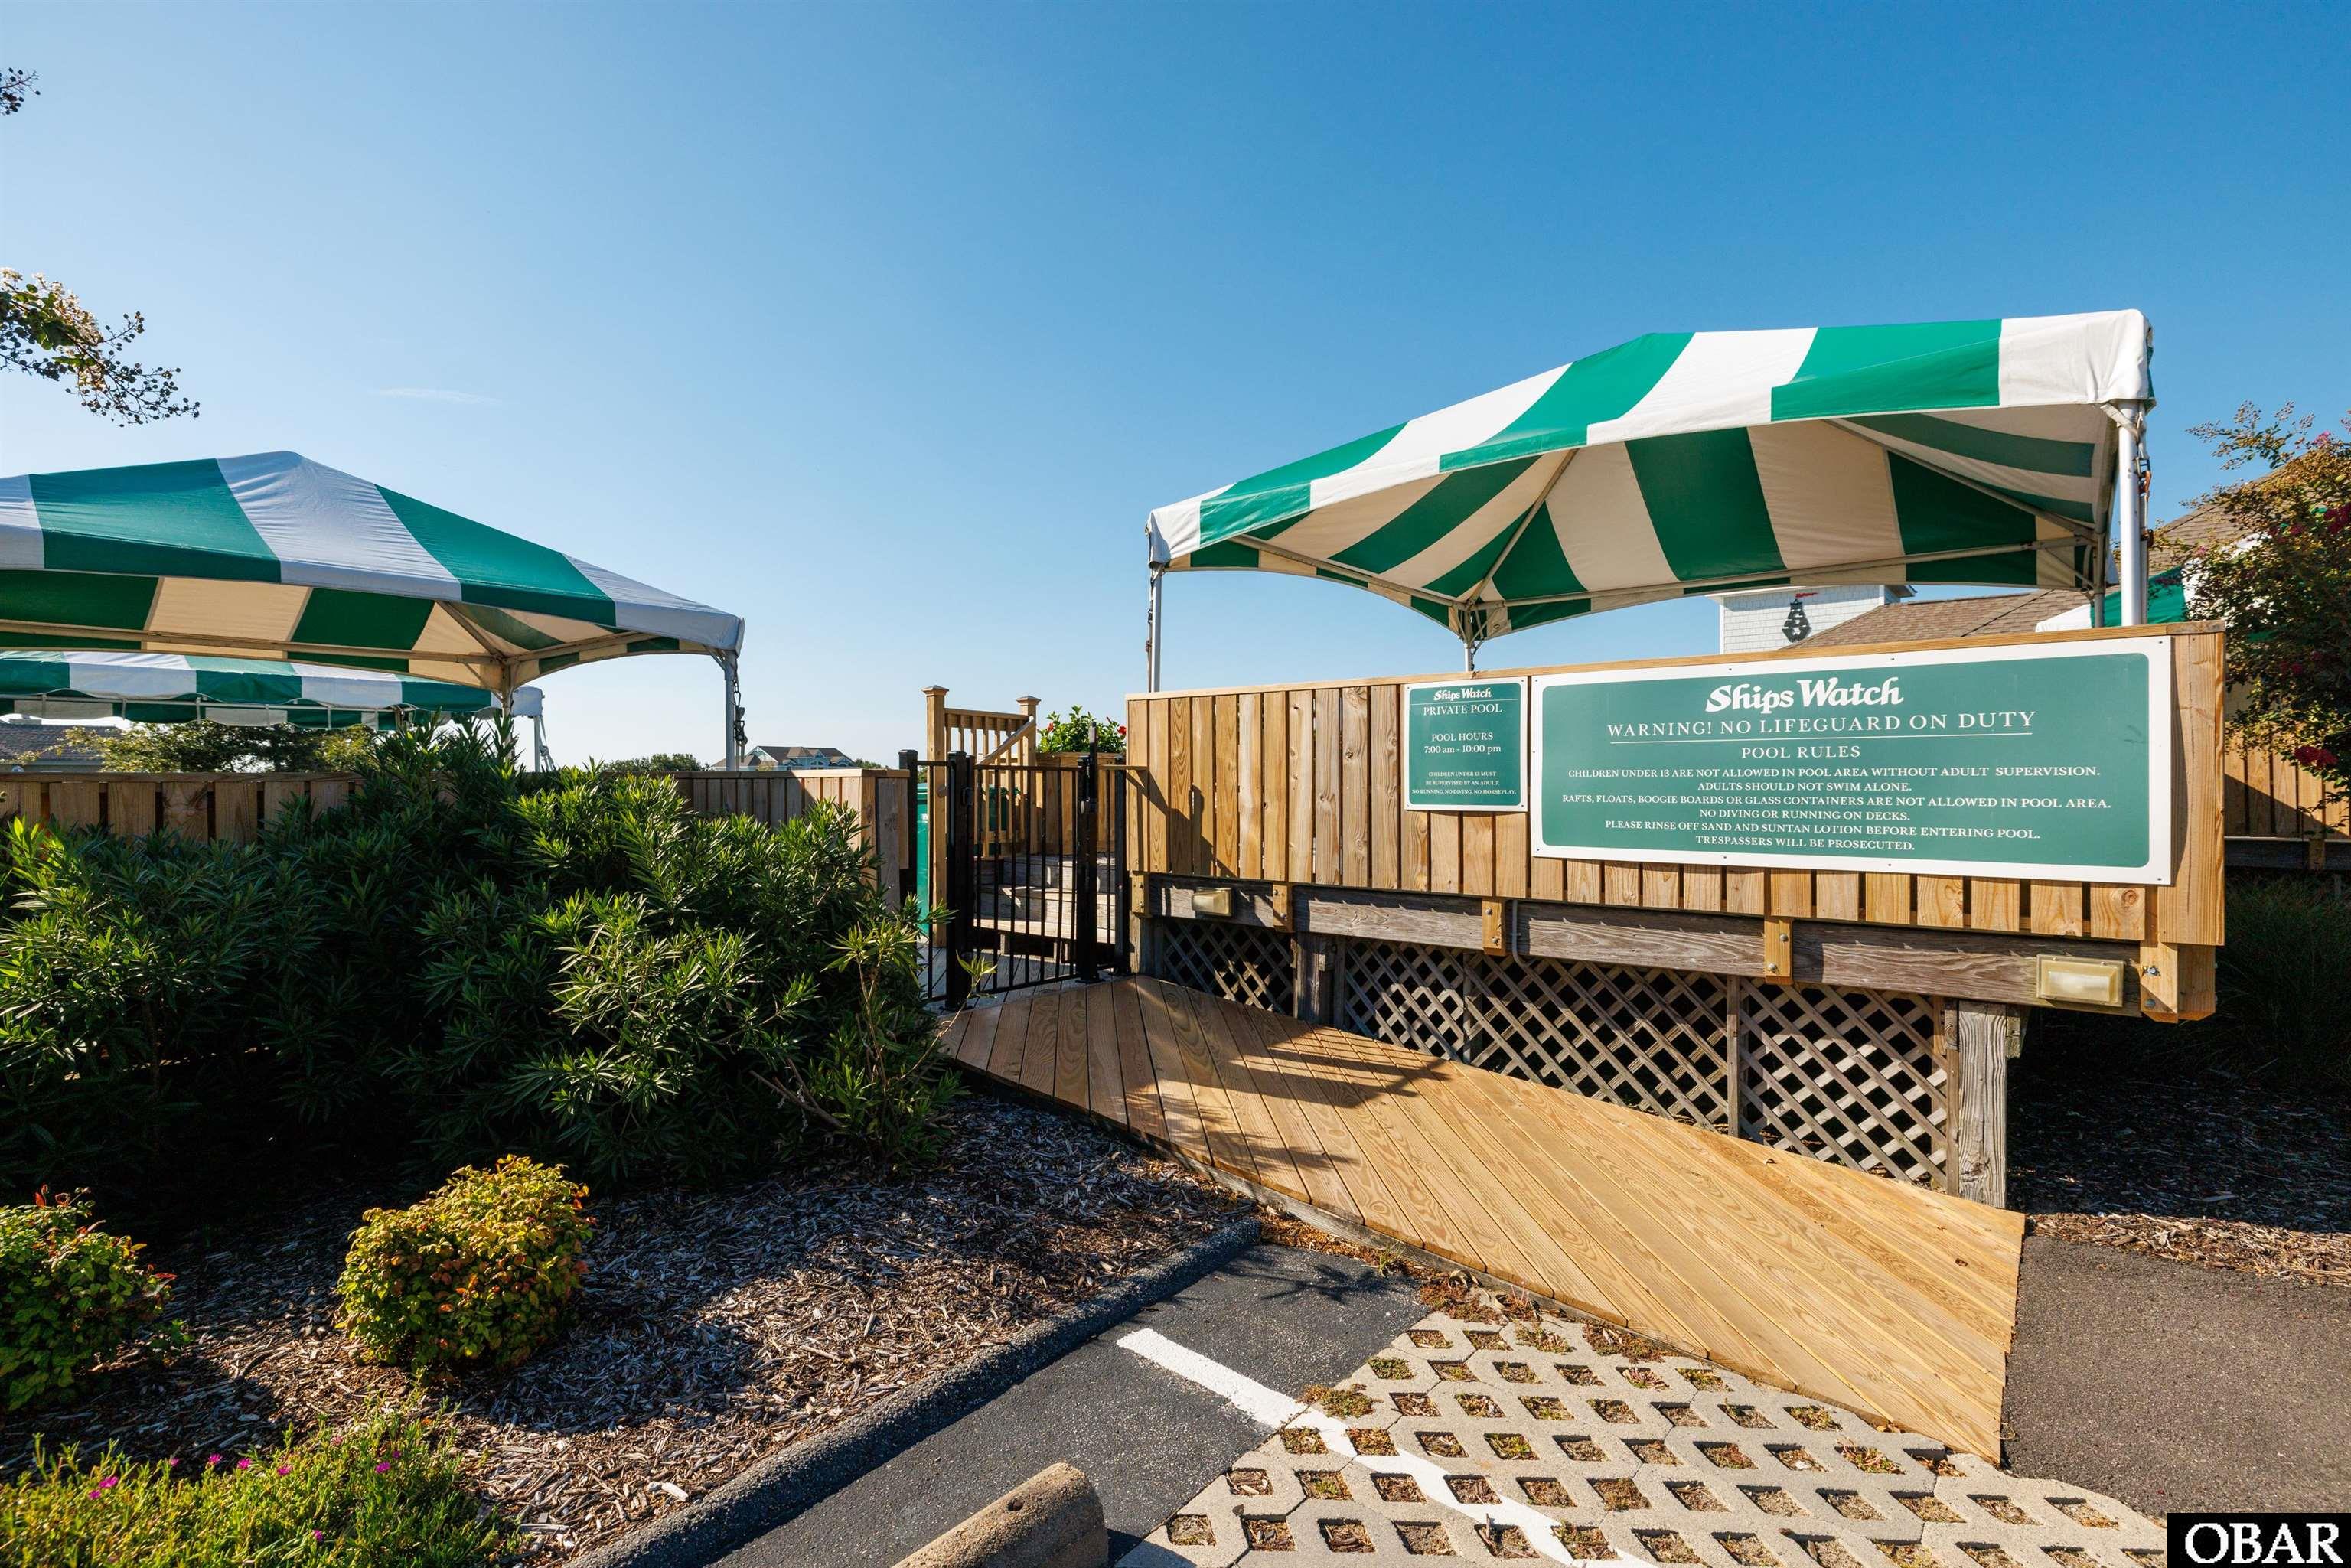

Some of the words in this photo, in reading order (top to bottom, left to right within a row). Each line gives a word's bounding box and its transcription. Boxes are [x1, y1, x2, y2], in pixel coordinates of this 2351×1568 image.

[1433, 689, 1460, 701] Ships
[1461, 687, 1492, 699] Watch
[1705, 686, 1794, 714] Ships
[1796, 676, 1904, 708] Watch
[1423, 705, 1468, 716] PRIVATE
[1471, 703, 1502, 714] POOL
[1606, 721, 1712, 737] WARNING!
[1720, 720, 1752, 735] NO
[1759, 716, 1901, 734] LIFEGUARD
[1909, 714, 1948, 730] ON
[1958, 710, 2036, 729] DUTY
[1432, 733, 1456, 742] POOL
[1459, 732, 1493, 741] HOURS
[1424, 745, 1441, 754] 7:00
[1462, 744, 1485, 753] 10:00
[1487, 746, 1502, 755] pm
[1741, 746, 1791, 759] POOL
[1797, 745, 1861, 758] RULES
[1568, 768, 1619, 778] CHILDREN
[1621, 768, 1658, 777] UNDER
[1660, 768, 1671, 777] 13
[1671, 768, 1694, 778] ARE
[1695, 768, 1720, 777] NOT
[1722, 768, 1780, 777] ALLOWED
[1782, 768, 1795, 777] IN
[1798, 768, 1832, 777] POOL
[1834, 768, 1869, 777] AREA
[1870, 767, 1939, 777] WITHOUT
[1940, 767, 1990, 777] ADULT
[1995, 766, 2101, 777] SUPERVISION.
[1697, 782, 1743, 791] ADULTS
[1744, 782, 1795, 791] SHOULD
[1797, 782, 1824, 791] NOT
[1826, 782, 1861, 791] SWIM
[1864, 782, 1912, 791] ALONE.
[1562, 794, 1595, 804] RAFTS,
[1596, 794, 1636, 804] FLOATS,
[1637, 795, 1678, 804] BOOGIE
[1679, 795, 1724, 804] BOARDS
[1725, 795, 1743, 804] OR
[1744, 796, 1782, 805] GLASS
[1782, 796, 1864, 806] CONTAINERS
[1866, 797, 1893, 806] ARE
[1896, 797, 1925, 807] NOT
[1927, 797, 1998, 807] ALLOWED
[2000, 797, 2018, 807] IN
[2020, 797, 2062, 808] POOL
[2065, 798, 2111, 809] AREA.
[1700, 809, 1717, 818] NO
[1718, 809, 1760, 819] DIVING
[1761, 810, 1779, 819] OR
[1782, 810, 1841, 820] RUNNING
[1842, 810, 1862, 820] ON
[1865, 811, 1911, 821] DECKS.
[1605, 820, 1643, 830] PLEASE
[1644, 820, 1677, 830] RINSE
[1678, 821, 1700, 830] OFF
[1701, 822, 1733, 832] SAND
[1733, 823, 1759, 832] AND
[1761, 823, 1811, 833] SUNTAN
[1813, 824, 1863, 834] LOTION
[1865, 826, 1918, 836] BEFORE
[1920, 826, 1994, 838] ENTERING
[1997, 828, 2041, 839] POOL.
[1695, 835, 1773, 846] TRESPASSERS
[1775, 837, 1807, 847] WILL
[1809, 838, 1825, 848] BE
[1828, 839, 1915, 850] PROSECUTED.
